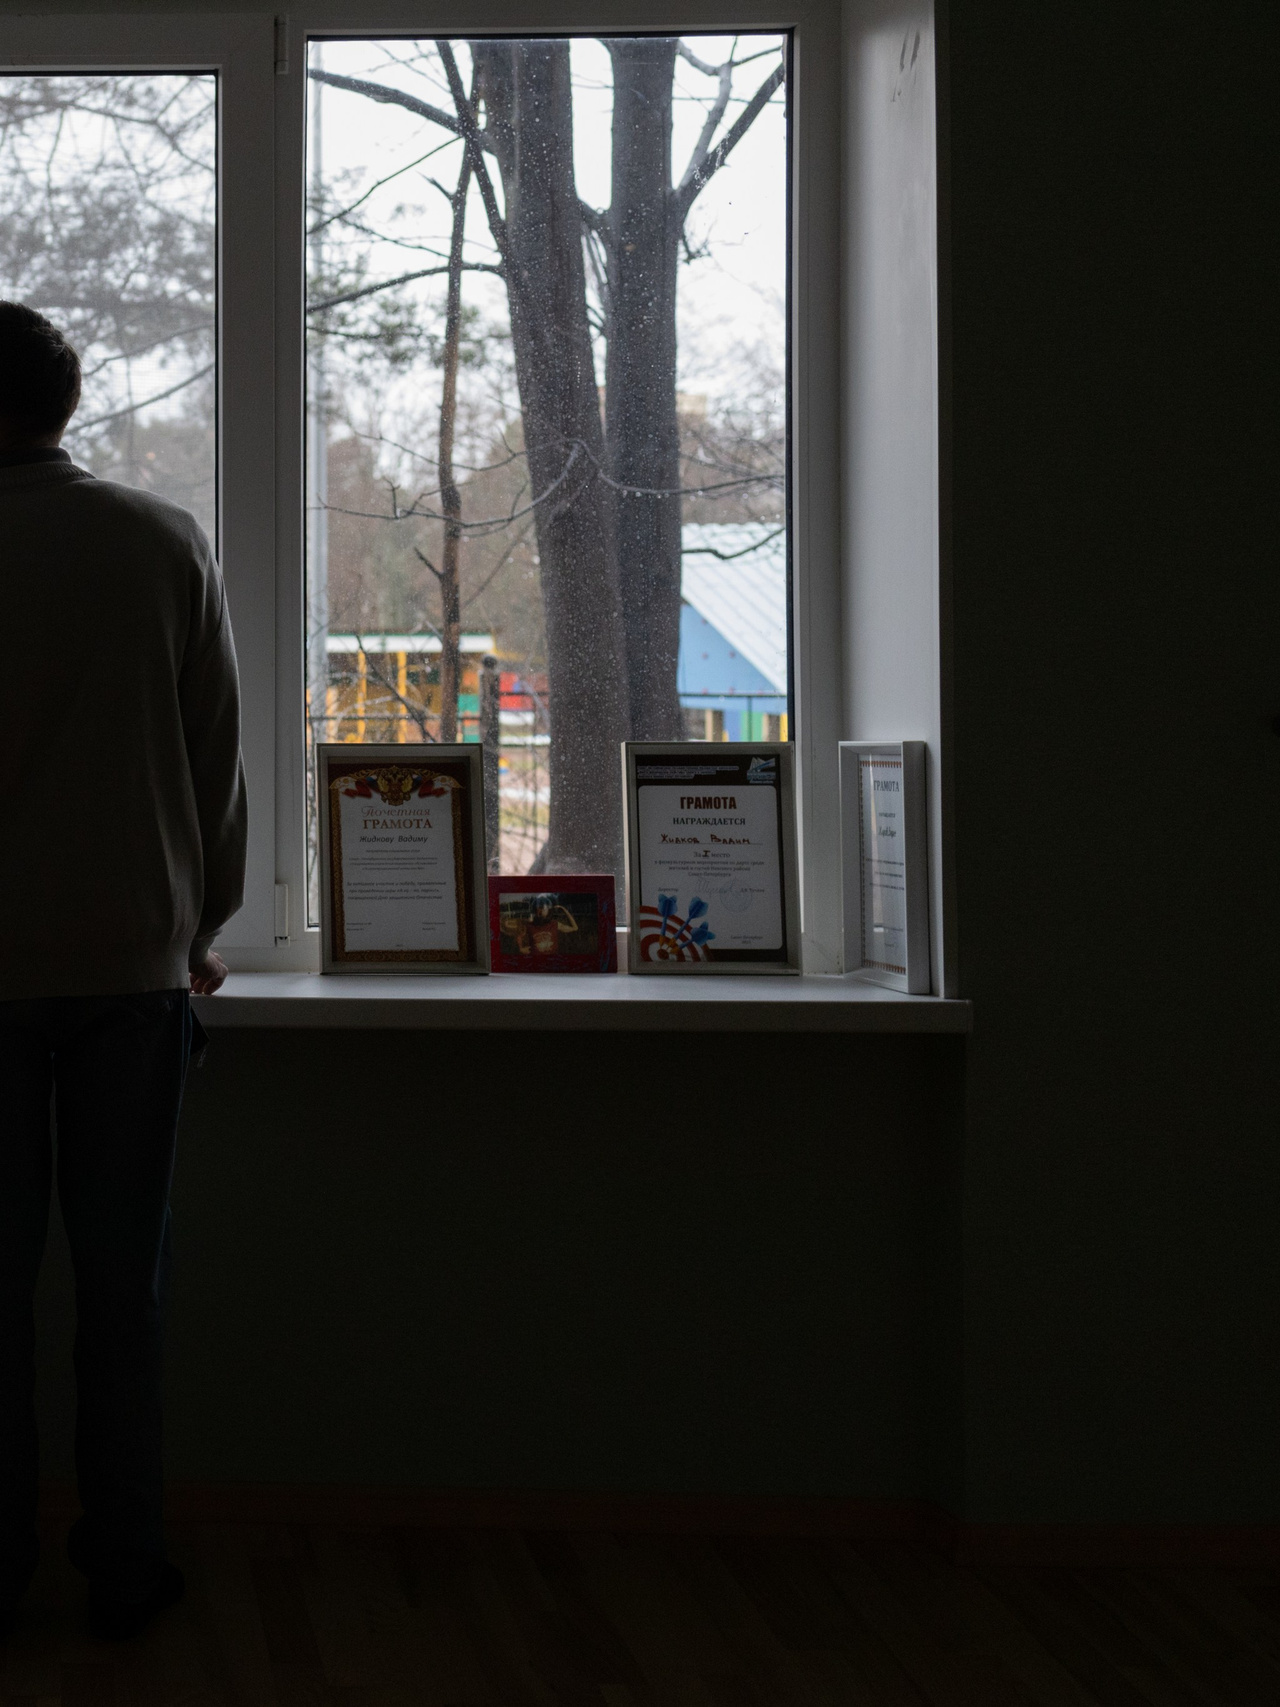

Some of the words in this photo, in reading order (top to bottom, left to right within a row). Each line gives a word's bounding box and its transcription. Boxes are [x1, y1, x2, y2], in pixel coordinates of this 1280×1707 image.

[873, 780, 900, 792] ГРАМОТА
[680, 796, 737, 810] ГРАМОТА
[361, 805, 431, 818] Почетная
[363, 818, 433, 830] ГРАМОТА
[673, 817, 746, 826] НАГРАЖДАЕТСЯ
[359, 835, 395, 844] Жидкову
[398, 834, 428, 844] Вадиму
